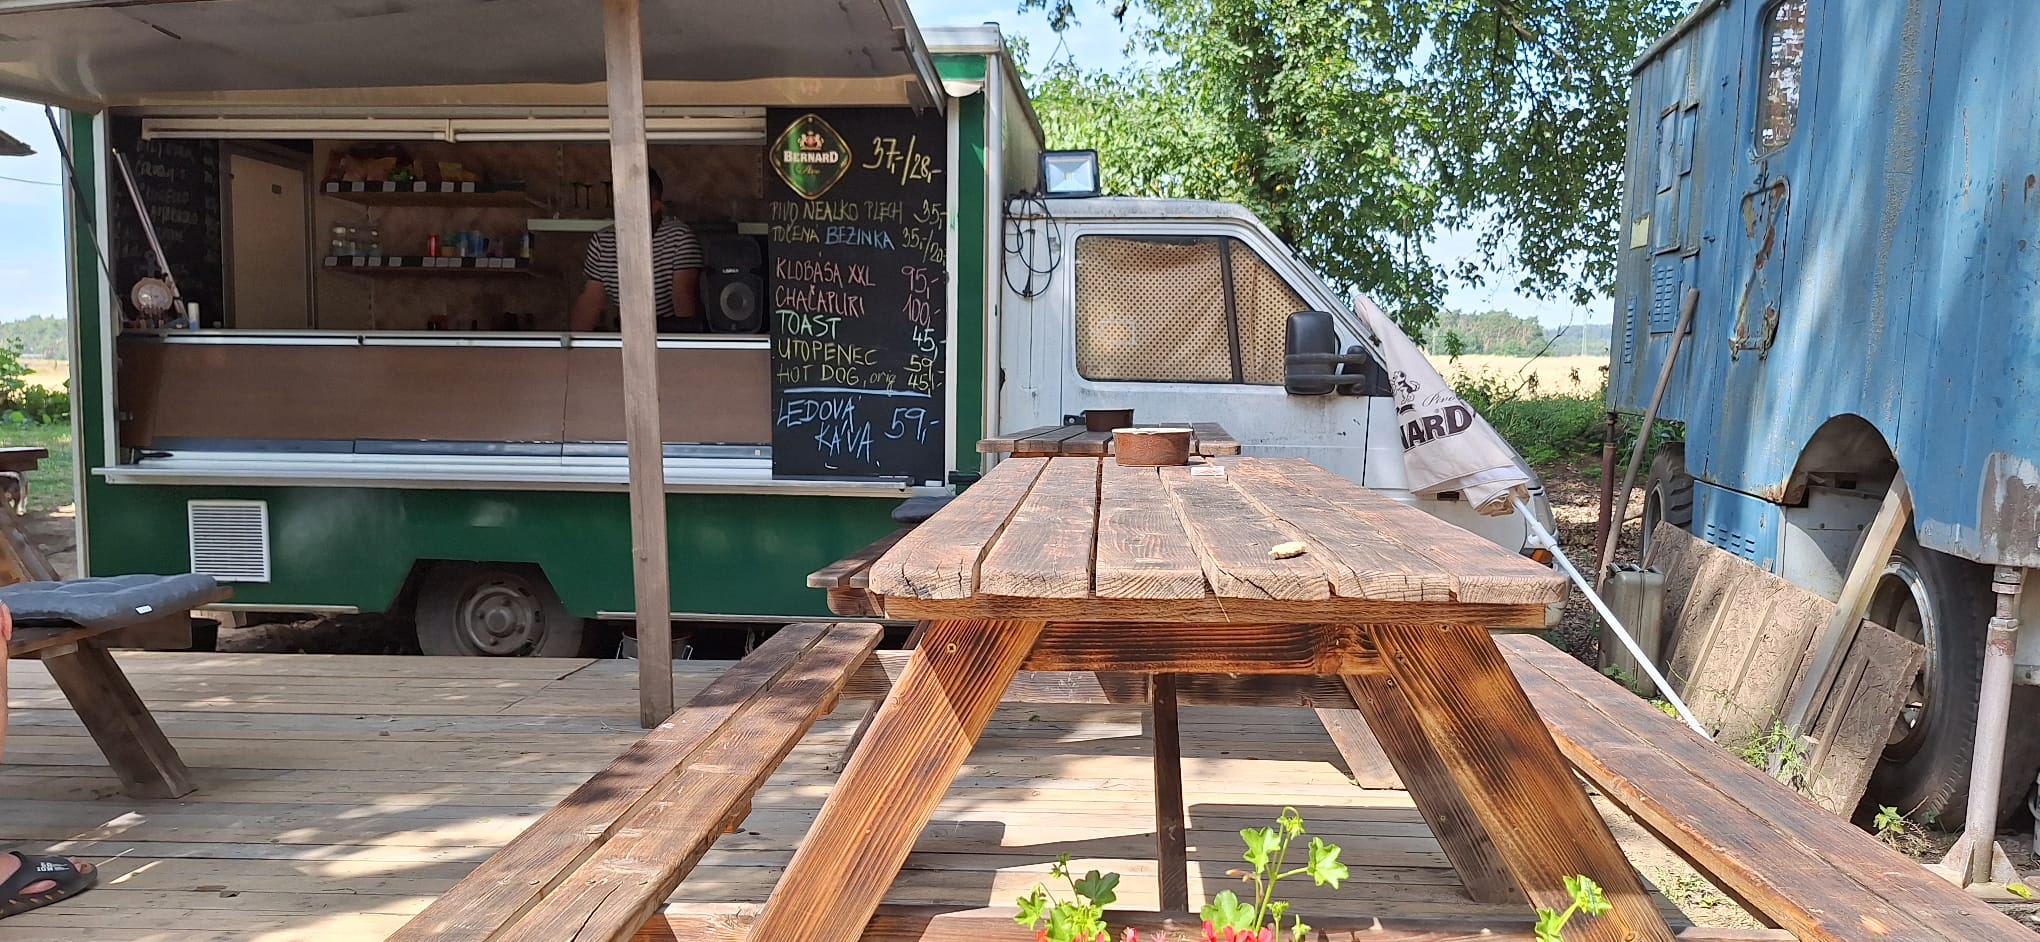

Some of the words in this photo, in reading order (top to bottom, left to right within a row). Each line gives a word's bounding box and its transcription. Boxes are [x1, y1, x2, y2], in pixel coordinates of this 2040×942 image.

[783, 150, 839, 164] BERNARD
[769, 200, 799, 227] PIVO
[802, 200, 859, 223] NEALKO
[863, 200, 903, 224] PLECH
[825, 226, 895, 250] BEZINKA
[776, 252, 843, 288] KLOBÁSA
[848, 264, 876, 287] XXL
[775, 284, 865, 318] CHAČAPURI
[776, 310, 842, 340] TOAST
[778, 338, 878, 366] UTOPENEC
[777, 364, 815, 385] HOT
[777, 395, 862, 432] LEDOVÁ
